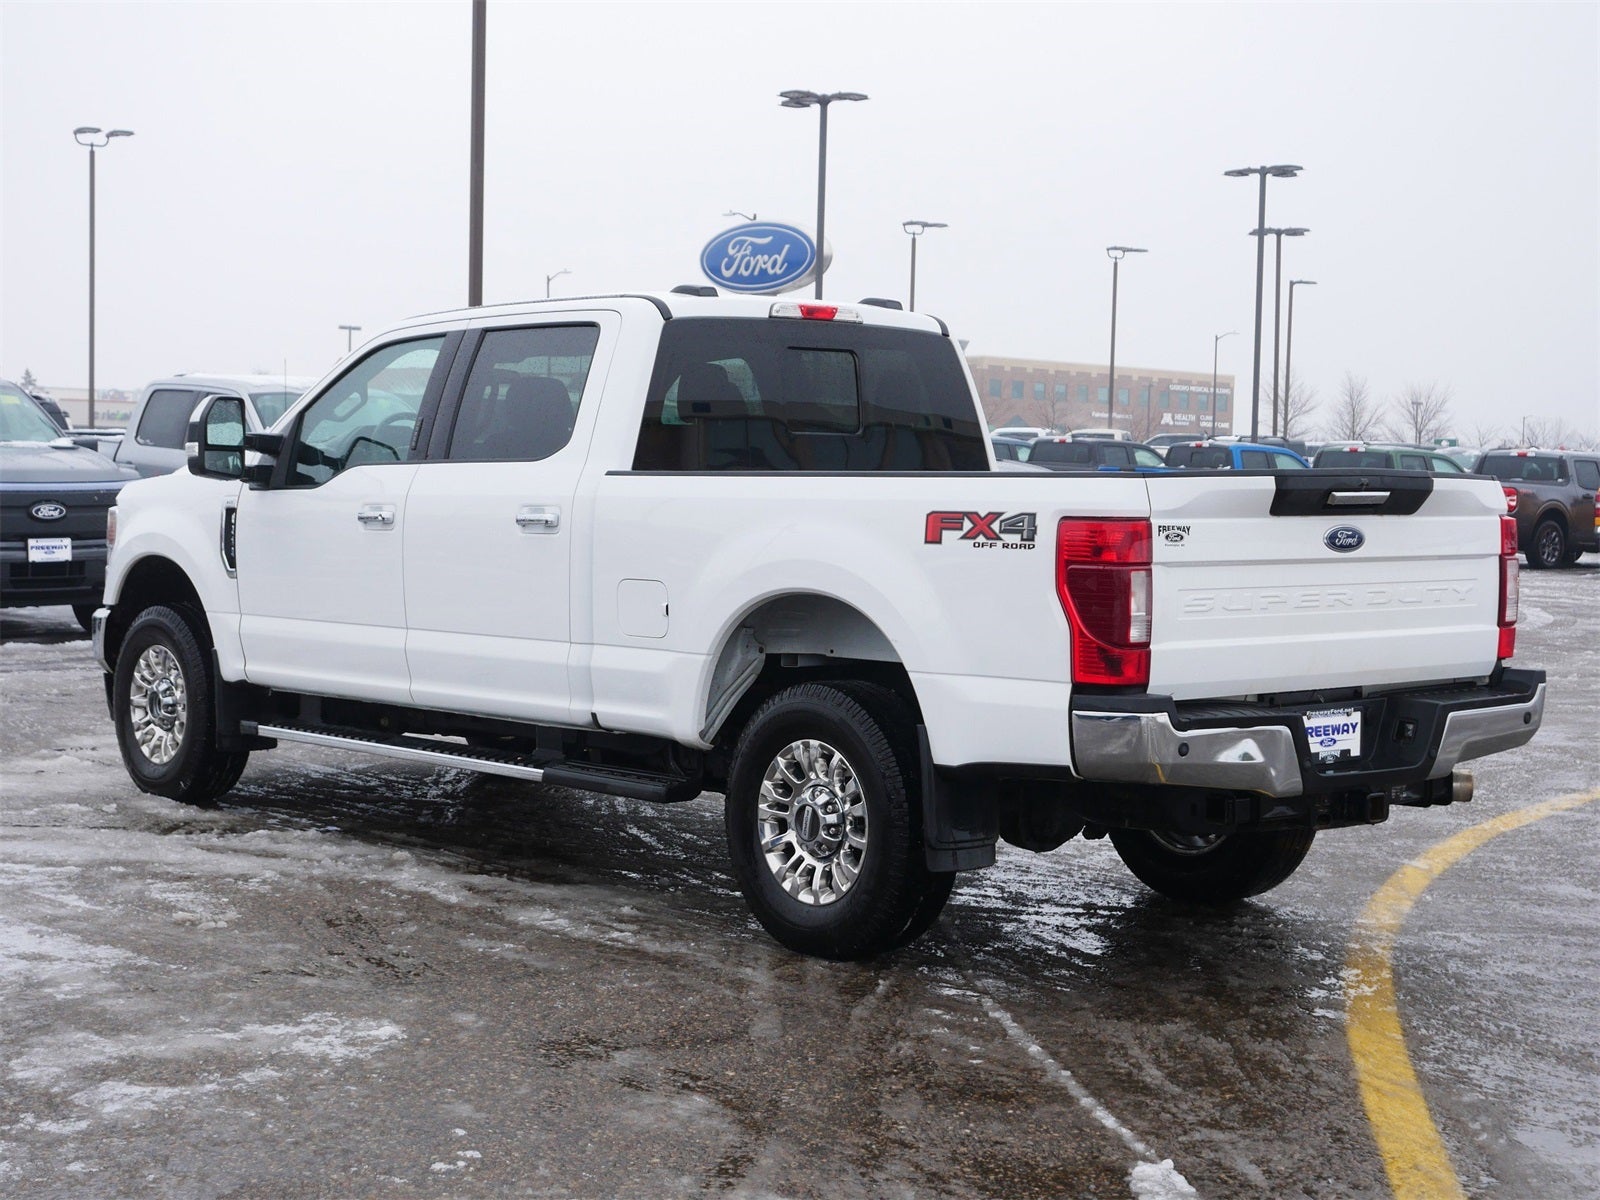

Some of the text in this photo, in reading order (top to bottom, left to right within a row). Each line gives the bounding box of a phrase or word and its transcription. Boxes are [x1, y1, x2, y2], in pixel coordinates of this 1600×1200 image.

[721, 236, 790, 277] Ford
[1174, 413, 1196, 422] HEALTH
[37, 505, 60, 516] Ford
[924, 510, 1037, 544] FX4
[1157, 524, 1191, 537] FREEWAY
[972, 541, 1036, 550] OFF ROAD
[1335, 530, 1359, 546] Ford
[1183, 585, 1474, 613] SUPER DUTY
[1305, 722, 1358, 738] REEWAY
